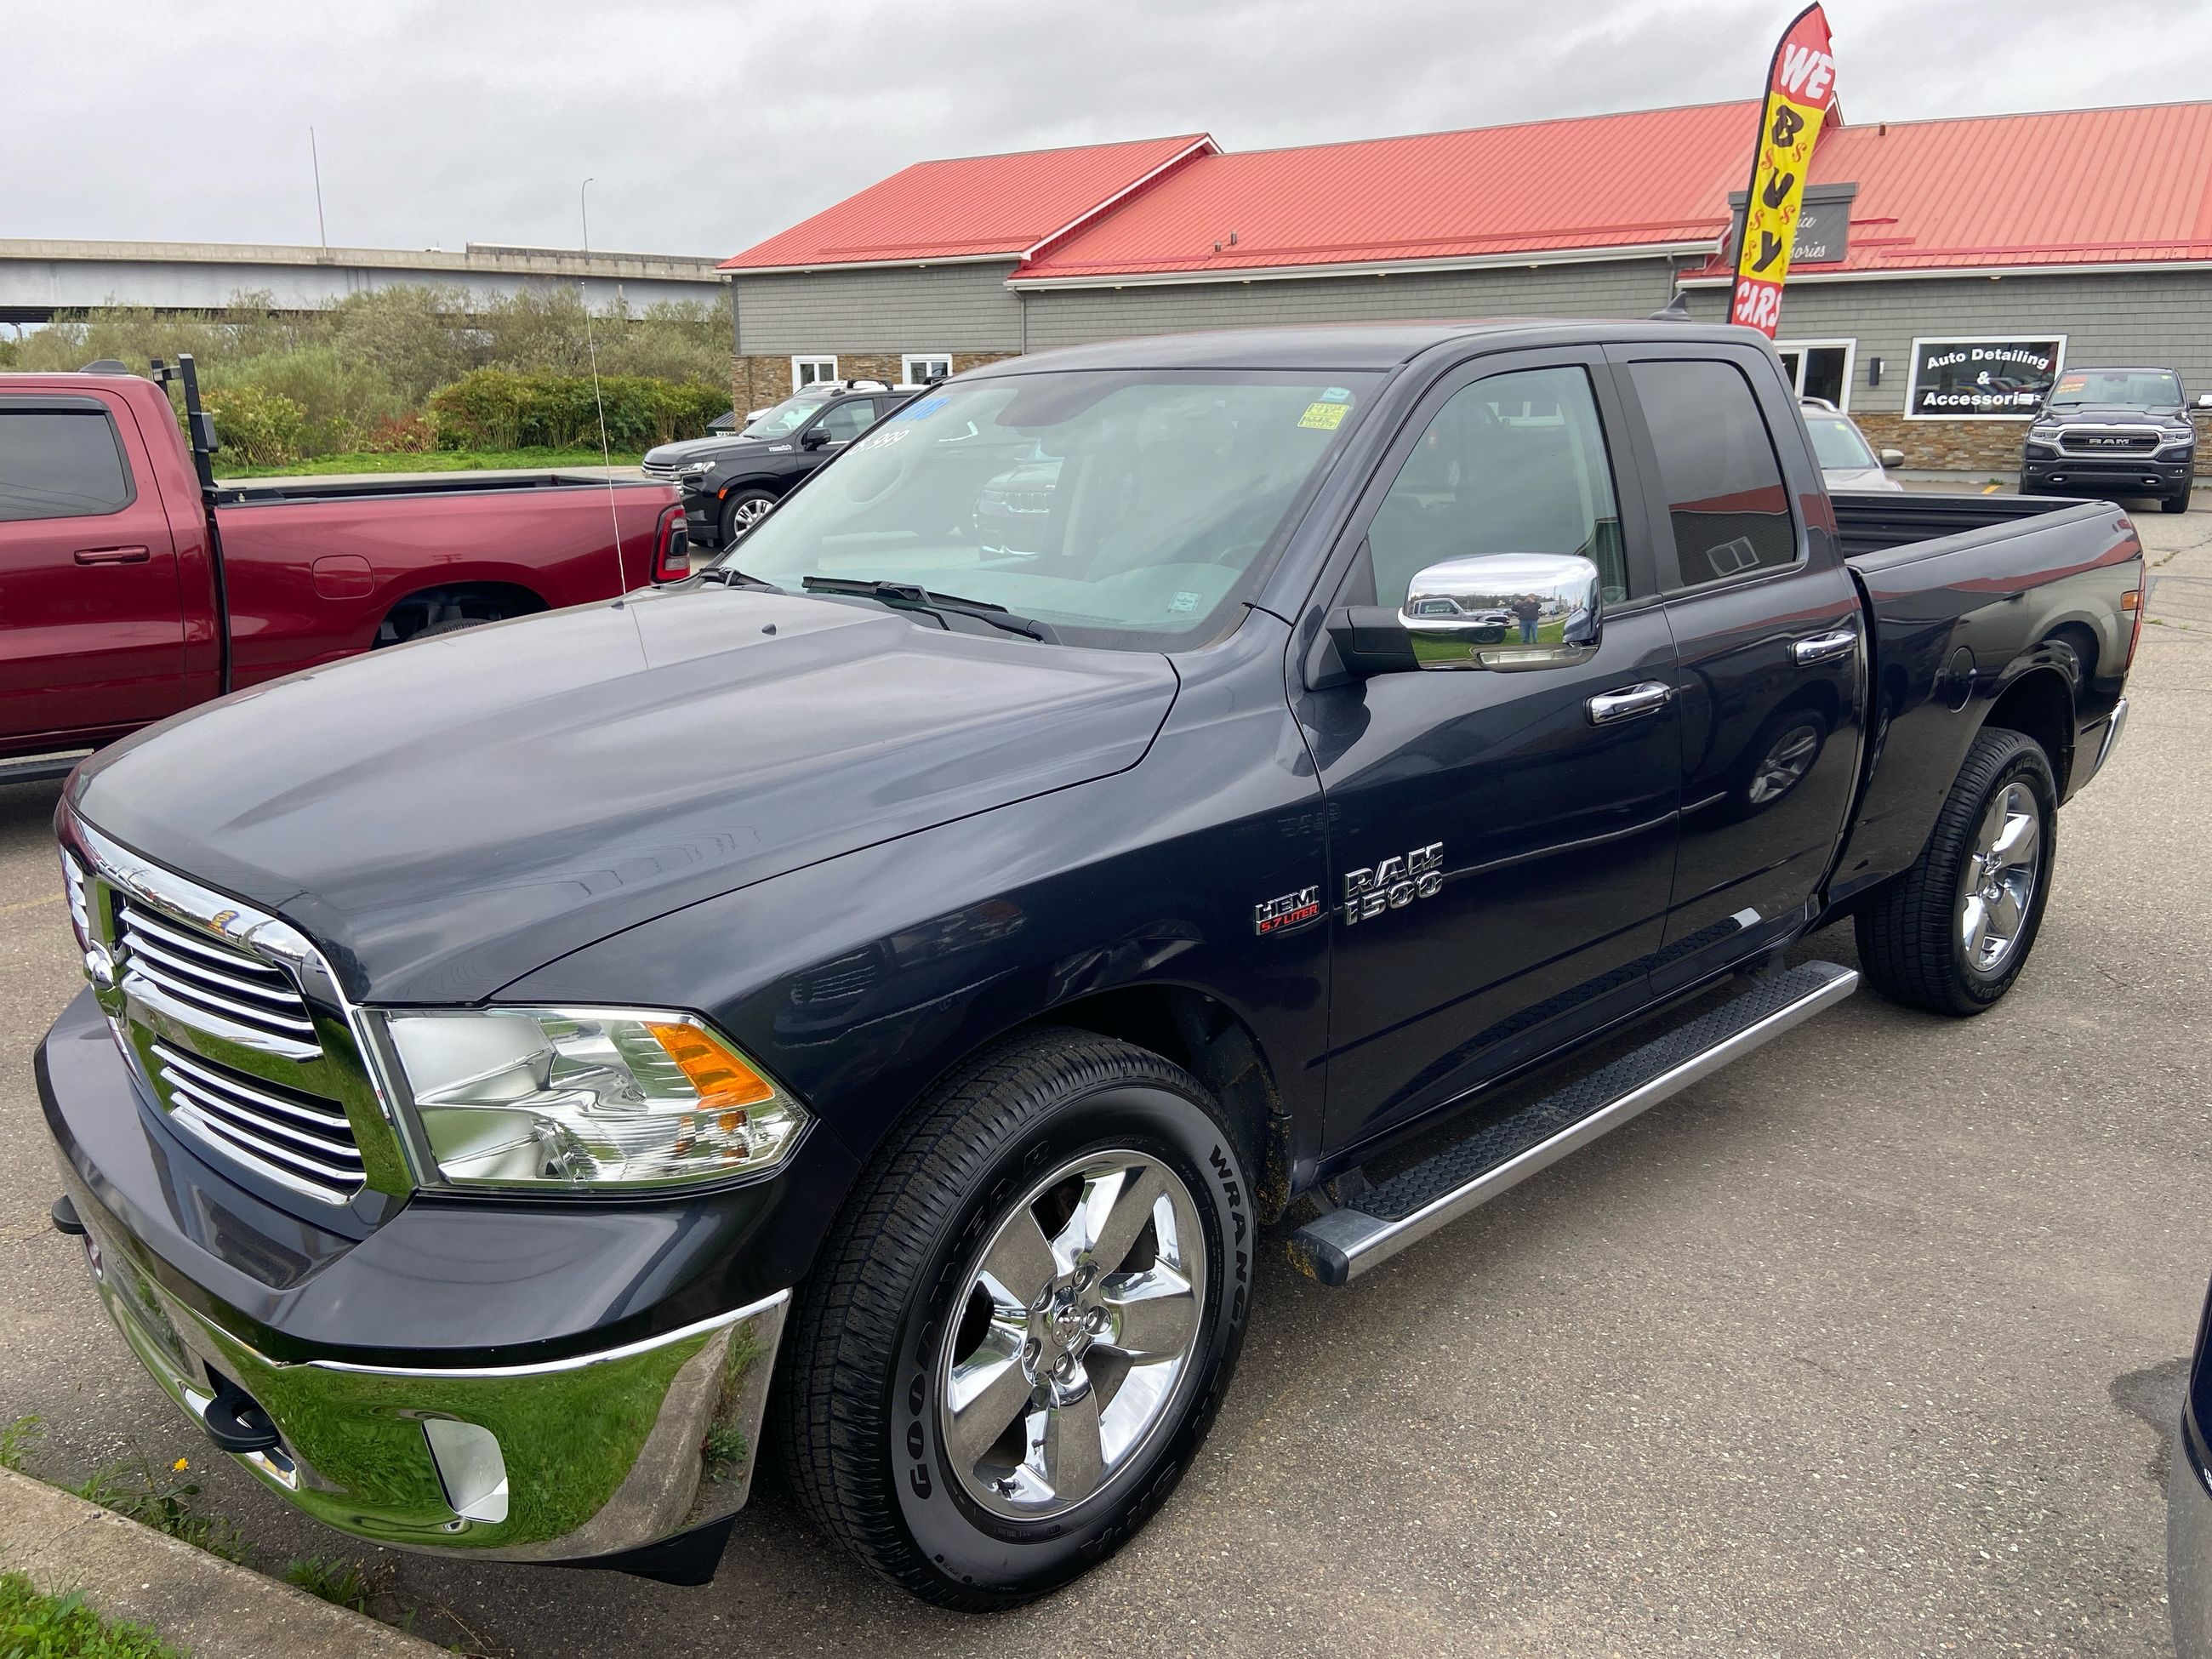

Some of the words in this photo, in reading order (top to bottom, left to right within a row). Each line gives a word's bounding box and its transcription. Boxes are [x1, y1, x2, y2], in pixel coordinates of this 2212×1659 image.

[1781, 43, 1835, 100] WE
[1736, 281, 1782, 328] CARS
[1927, 351, 1966, 369] Auto
[1971, 348, 2050, 370] Detailing
[1976, 371, 1991, 385] &
[1344, 841, 1443, 898] RAM
[1255, 884, 1320, 922] HEMI
[1260, 917, 1283, 932] 5.7
[1283, 903, 1318, 925] LITER
[1344, 870, 1443, 926] 1500
